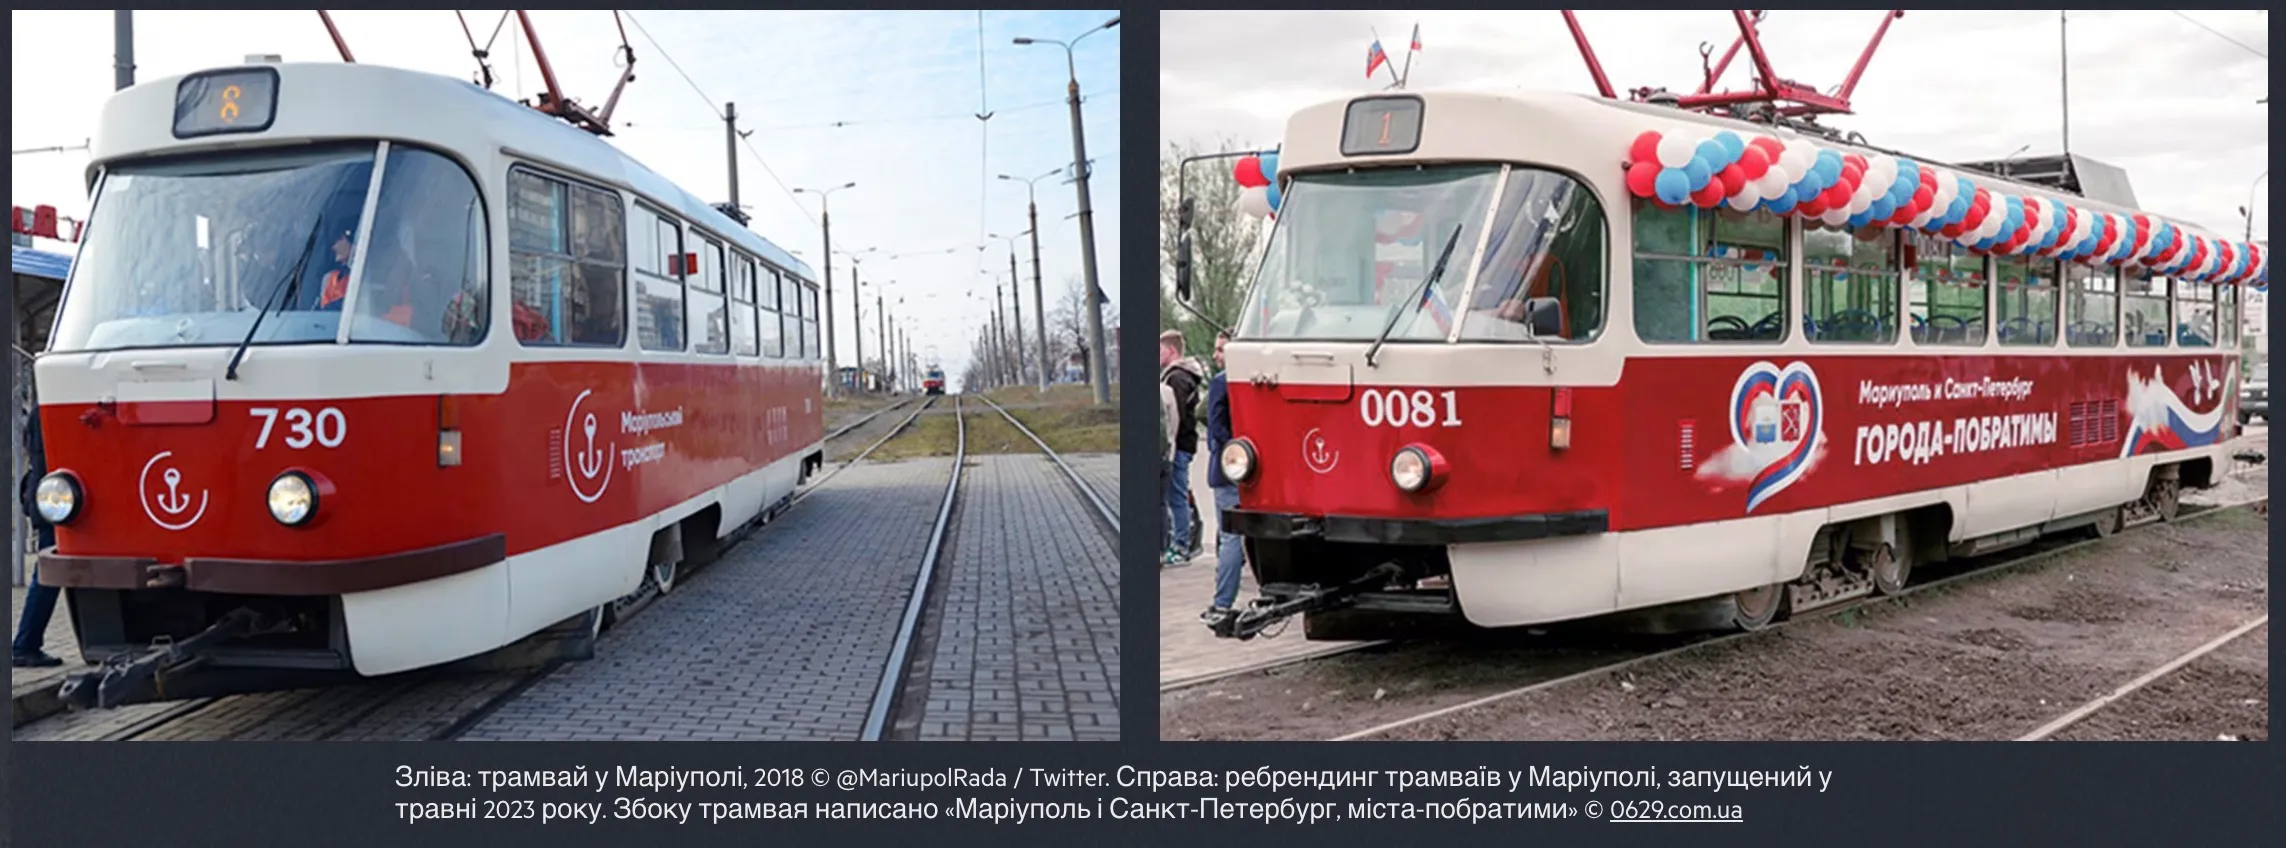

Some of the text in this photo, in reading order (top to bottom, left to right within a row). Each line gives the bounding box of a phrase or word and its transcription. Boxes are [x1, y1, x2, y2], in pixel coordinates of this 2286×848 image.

[1376, 111, 1393, 147] 1
[1360, 388, 1463, 428] 0081
[1859, 375, 2034, 409] Мариуполь и Санкт-Петербург
[249, 406, 347, 449] 730
[1854, 411, 2059, 466] ГОРОДА-ПОБРАТИМЫ
